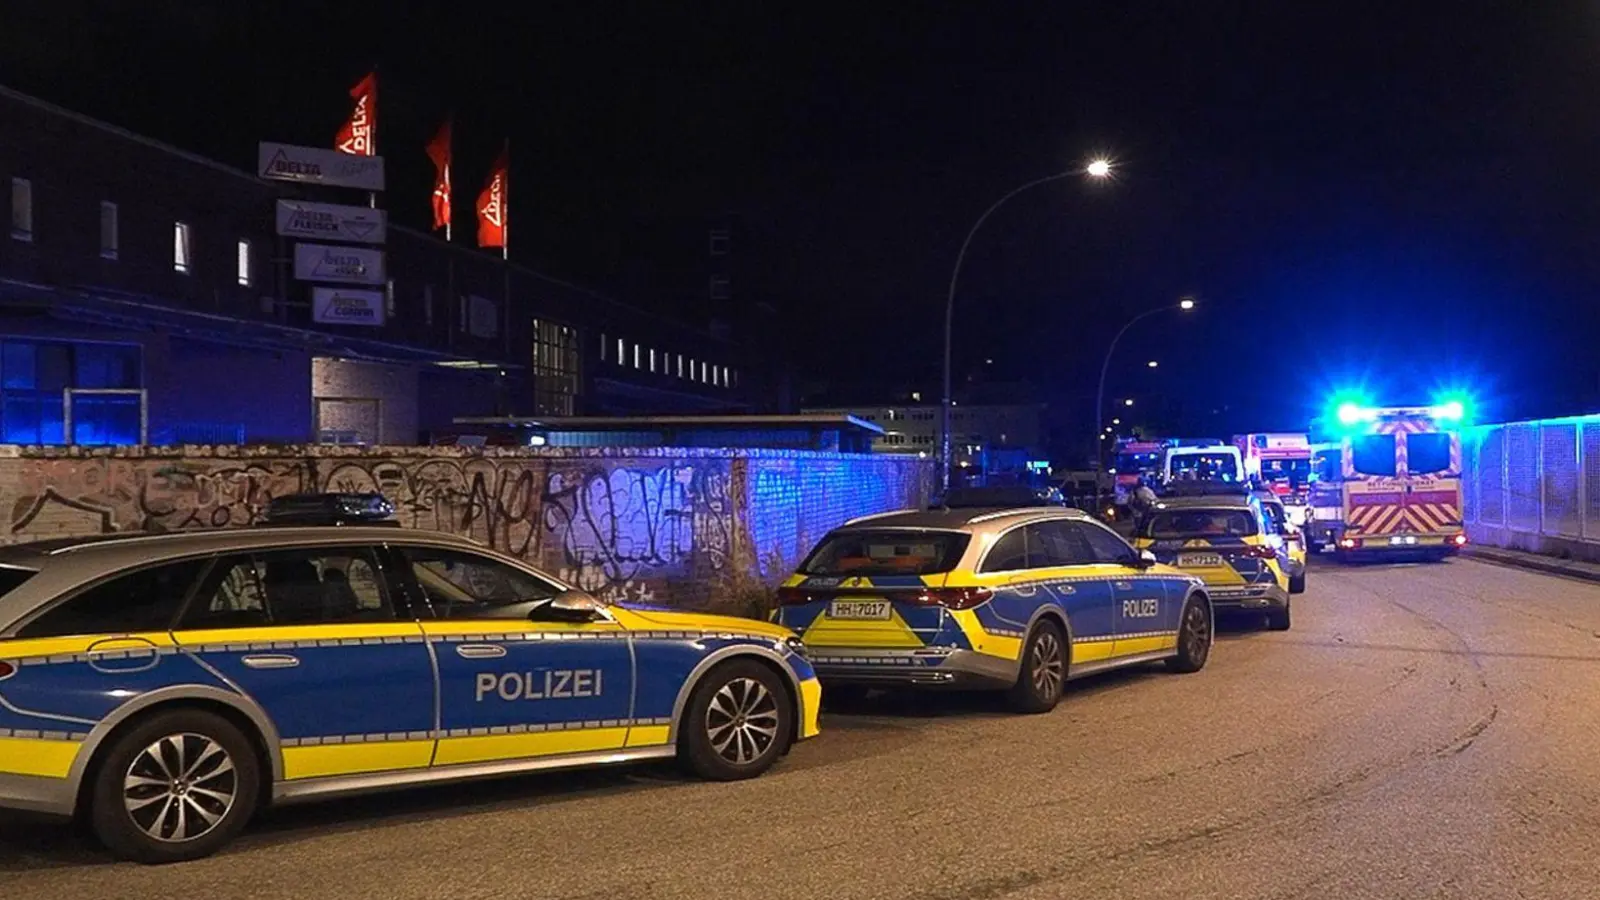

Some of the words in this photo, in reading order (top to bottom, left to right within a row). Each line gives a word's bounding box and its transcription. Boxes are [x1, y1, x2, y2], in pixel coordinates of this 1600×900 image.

[276, 160, 321, 175] DELTA
[1123, 598, 1159, 618] POLIZEI
[476, 669, 602, 702] POLIZEI
